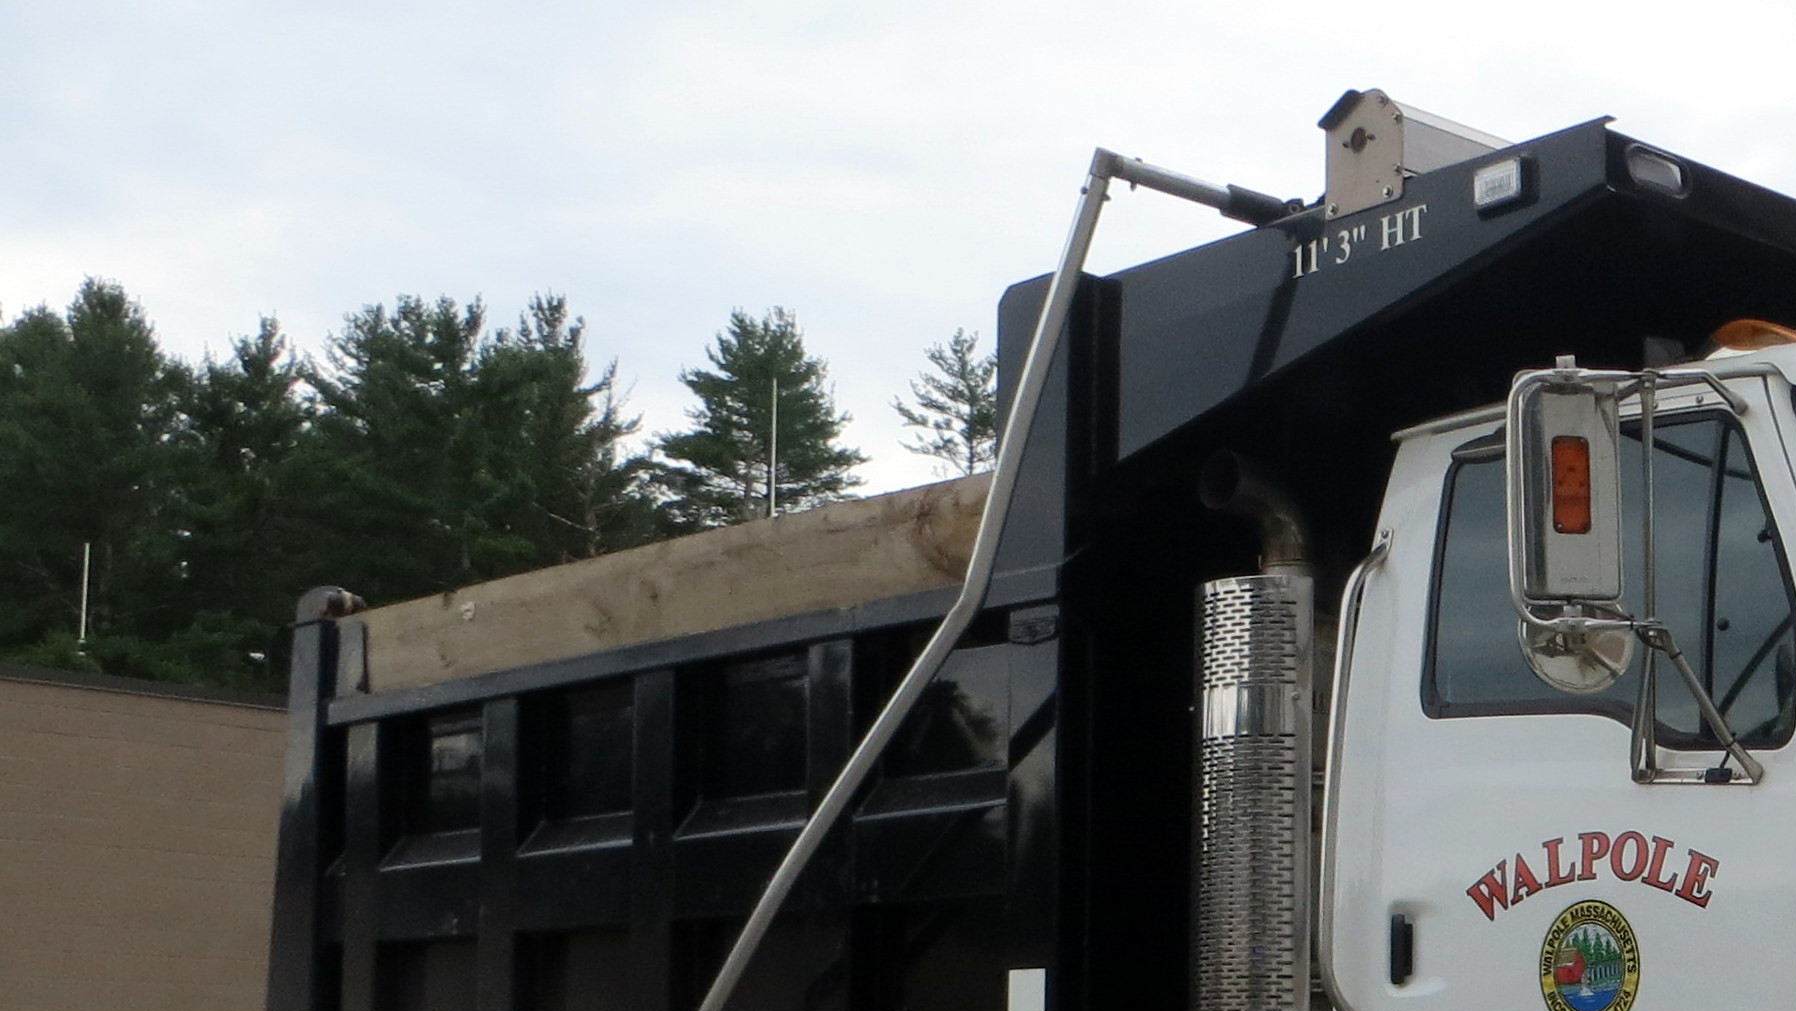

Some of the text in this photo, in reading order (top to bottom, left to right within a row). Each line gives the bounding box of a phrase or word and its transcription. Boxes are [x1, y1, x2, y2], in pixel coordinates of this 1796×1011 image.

[1292, 204, 1428, 279] 11' 3" HT
[1466, 830, 1721, 922] WALPOLE
[1543, 905, 1637, 977] WALPOLE MASSACHUSETTS
